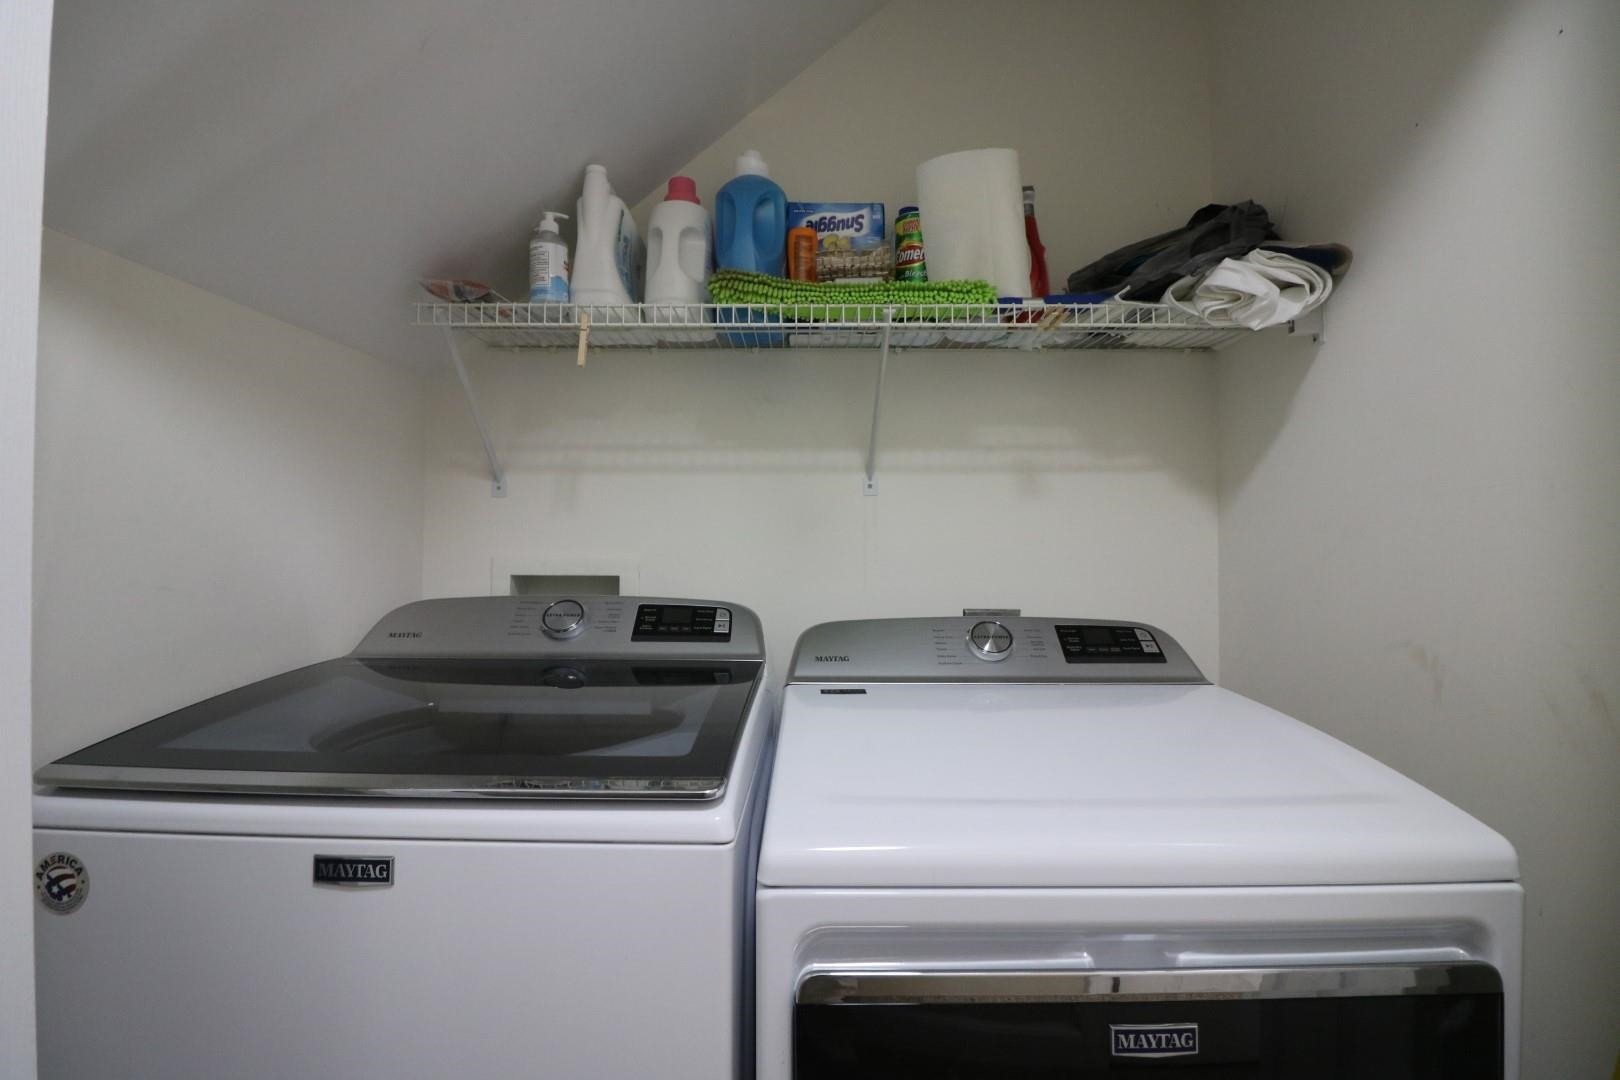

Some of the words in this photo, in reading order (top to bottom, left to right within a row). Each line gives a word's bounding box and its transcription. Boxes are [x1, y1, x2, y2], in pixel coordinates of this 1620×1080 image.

[387, 631, 423, 639] MAYTAG
[815, 655, 850, 663] MAYTAG
[36, 855, 83, 881] AMERICA
[319, 863, 388, 879] MAYTAG
[1117, 1032, 1194, 1049] MAYTAG
